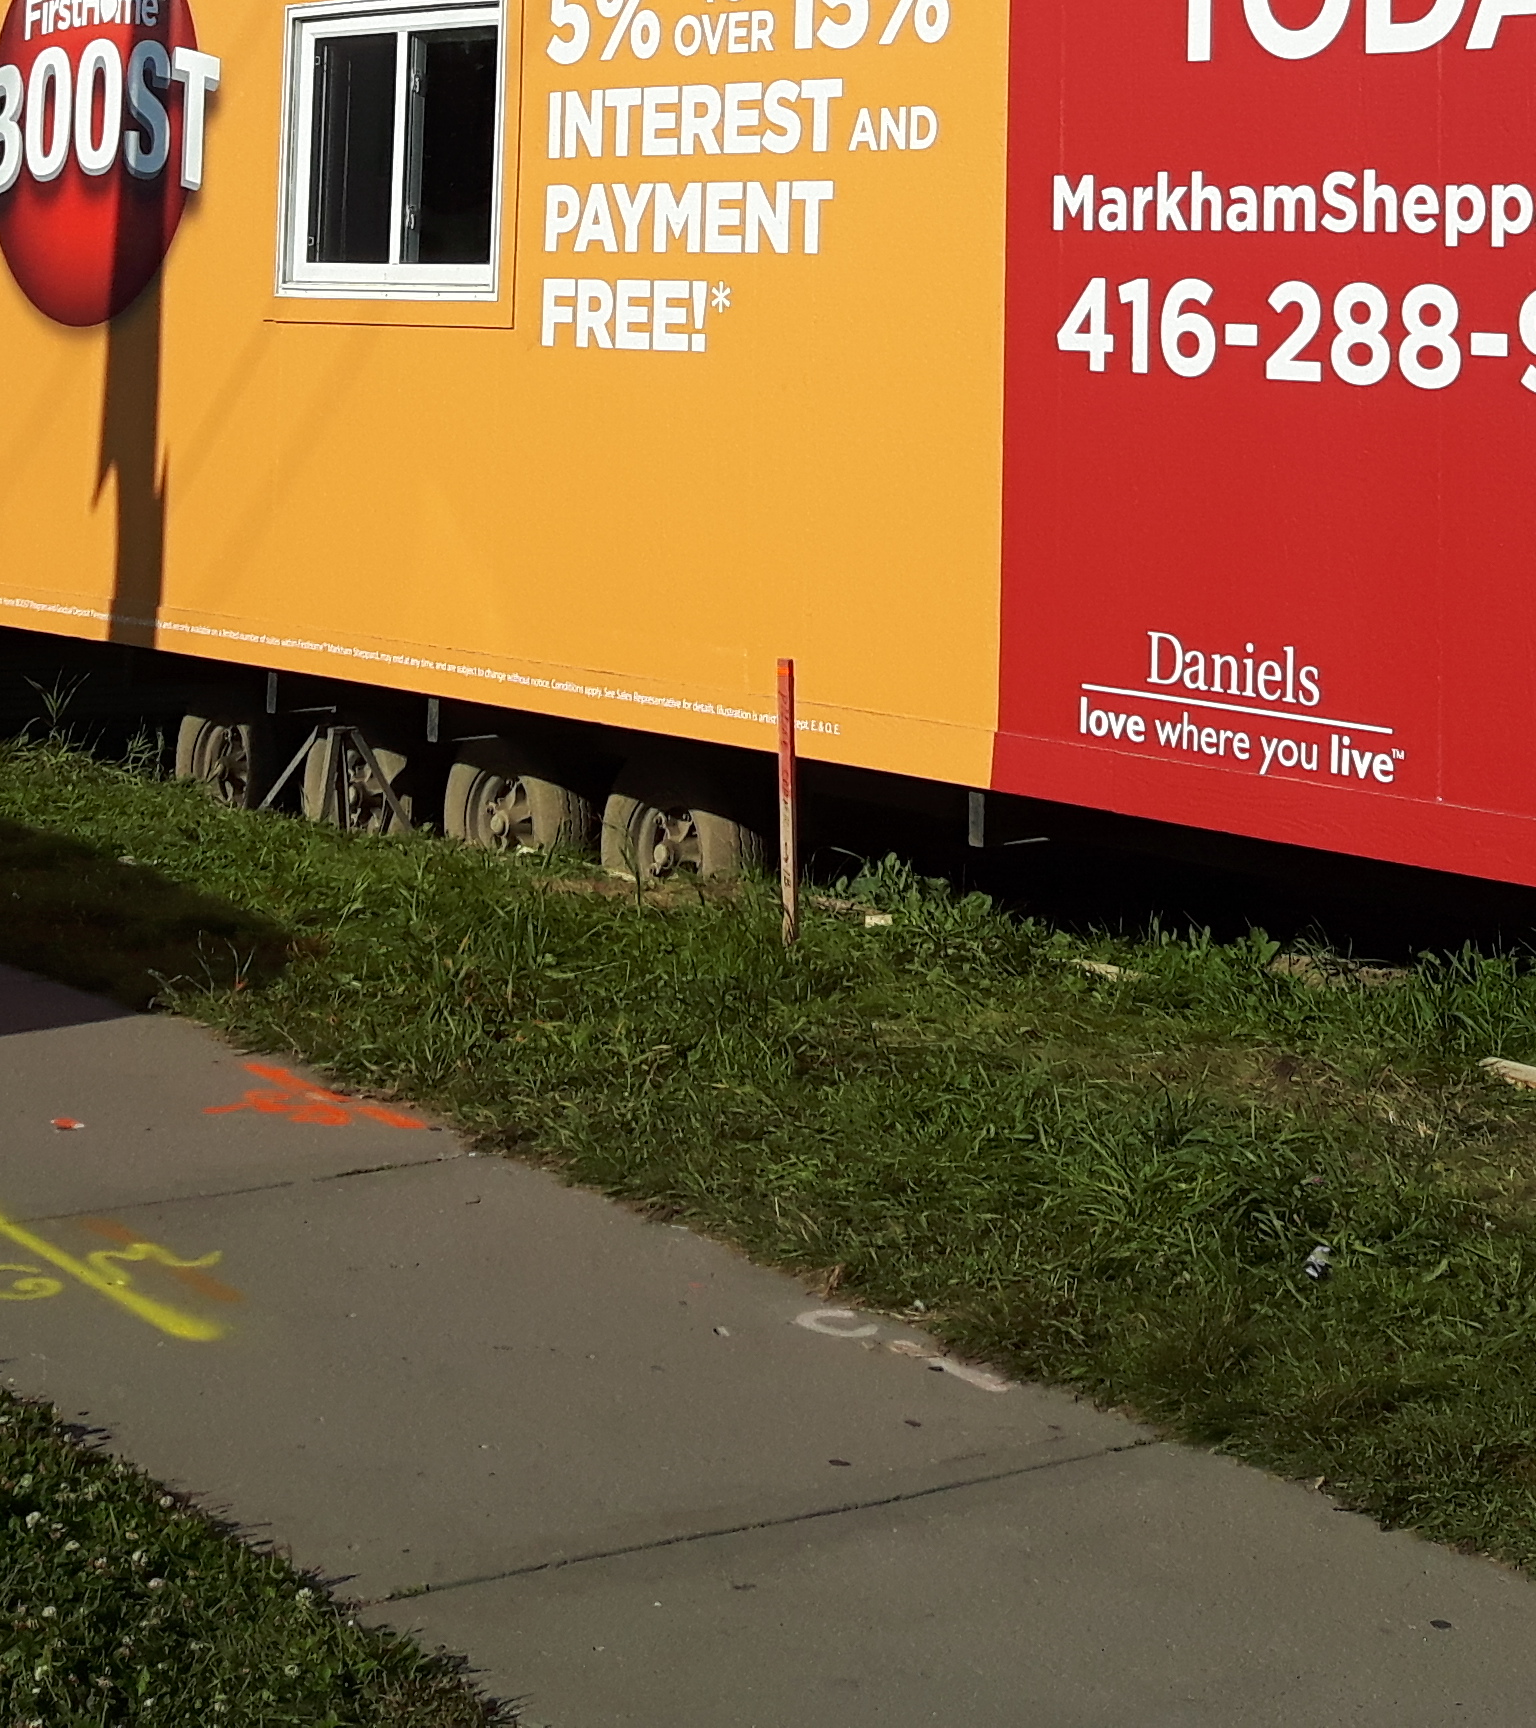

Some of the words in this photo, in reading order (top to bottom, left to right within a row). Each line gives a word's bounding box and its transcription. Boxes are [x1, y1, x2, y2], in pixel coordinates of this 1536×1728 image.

[674, 11, 774, 56] OVER
[549, 79, 842, 158] INTEREST
[849, 106, 937, 151] AND
[545, 181, 833, 254] PAYMENT
[1144, 632, 1319, 709] Daniels
[1079, 696, 1146, 742] love
[1154, 711, 1251, 760] where
[1260, 735, 1319, 775] you
